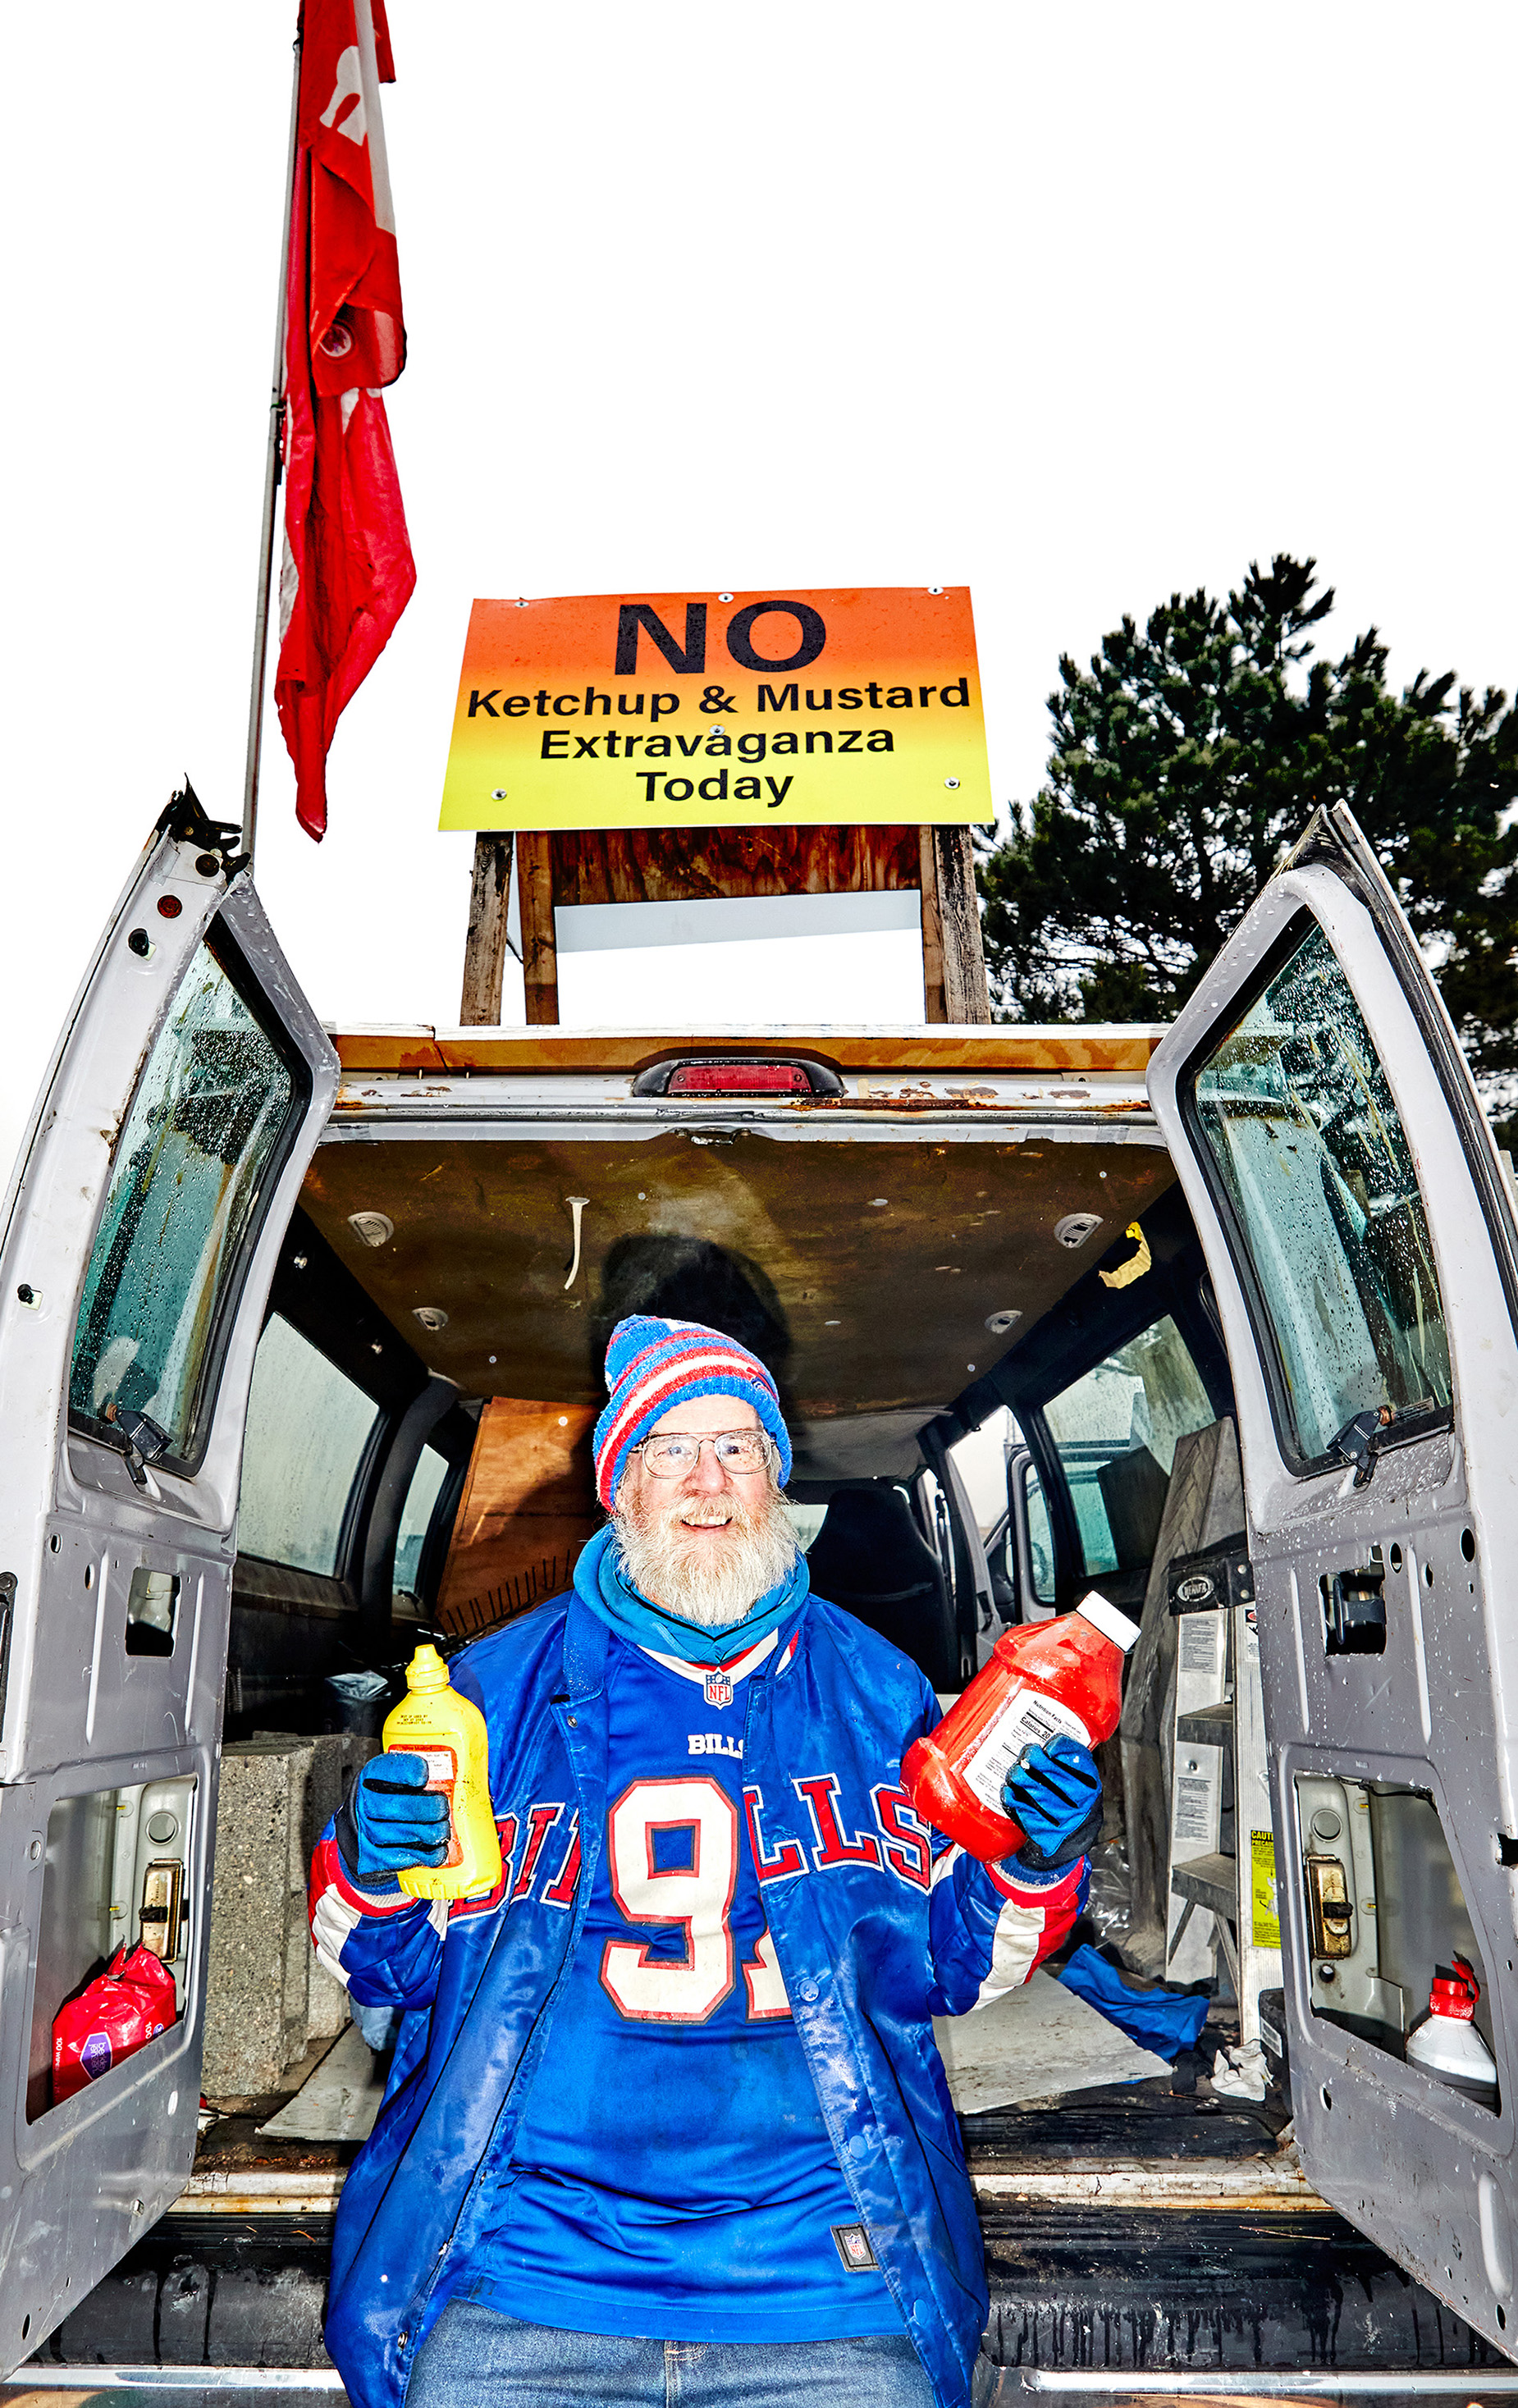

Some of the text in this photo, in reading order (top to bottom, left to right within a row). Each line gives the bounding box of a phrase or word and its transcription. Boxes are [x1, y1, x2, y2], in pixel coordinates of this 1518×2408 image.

[615, 600, 826, 675] NO
[468, 678, 970, 722] Ketchup & Mustard
[541, 729, 894, 763] Extravaganza
[636, 769, 794, 807] Today
[709, 1685, 730, 1702] NFL
[1041, 1730, 1051, 1739] 20
